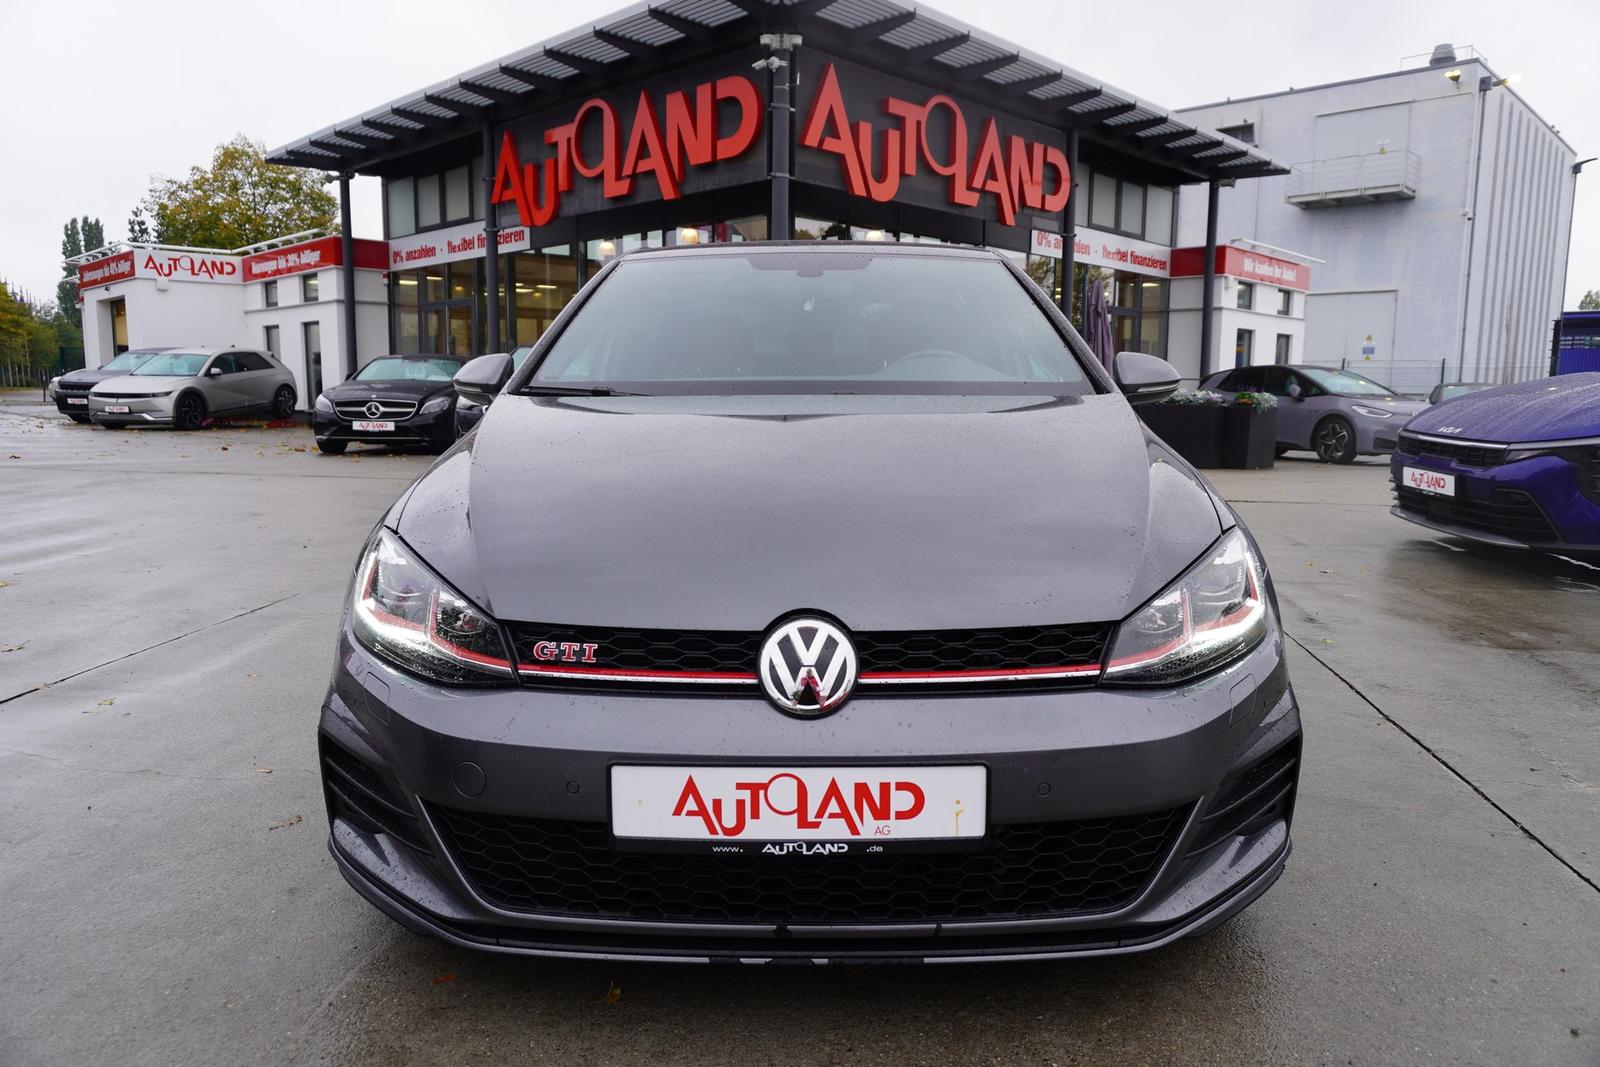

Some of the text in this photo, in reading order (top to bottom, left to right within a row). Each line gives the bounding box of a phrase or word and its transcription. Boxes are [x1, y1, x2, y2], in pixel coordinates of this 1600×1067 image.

[392, 249, 404, 264] 0%
[405, 245, 436, 261] anzahlen
[447, 236, 474, 254] flexibel
[1036, 231, 1051, 248] 0%
[1102, 244, 1128, 262] flexibel
[1130, 250, 1167, 271] finanzieren
[533, 640, 598, 662] GTI
[874, 825, 891, 836] AG
